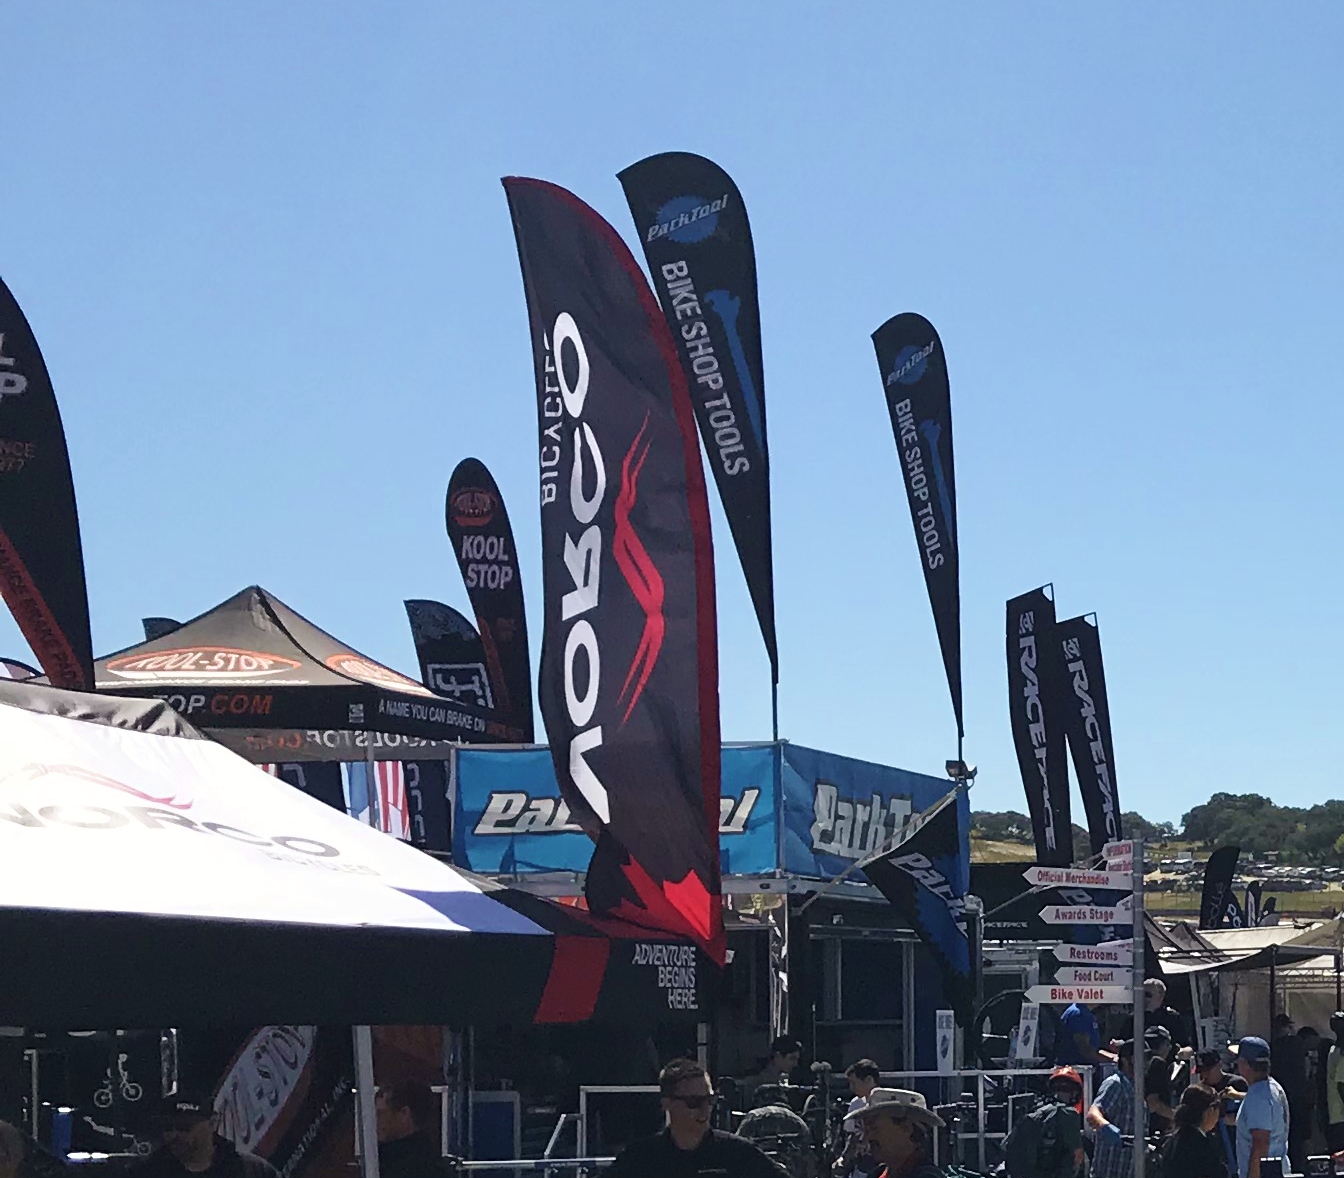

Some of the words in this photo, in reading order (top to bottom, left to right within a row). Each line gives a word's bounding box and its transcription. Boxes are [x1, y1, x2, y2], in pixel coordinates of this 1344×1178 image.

[661, 259, 702, 321] BIKE
[681, 320, 724, 391] SHOP
[705, 391, 750, 477] TOOLS
[895, 398, 918, 448] BIKE
[904, 446, 929, 501] SHOP
[461, 534, 509, 562] KOOL
[917, 502, 945, 570] TOOLS
[466, 563, 514, 590] STOP
[410, 704, 429, 721] YOU
[428, 706, 446, 723] CAN
[446, 709, 473, 730] BRAKE
[1067, 660, 1118, 842] RACEFAC
[1037, 869, 1064, 882] Official
[1065, 871, 1110, 885] Merchandise
[1054, 908, 1087, 920] Awards
[1089, 908, 1115, 922] Stage
[632, 943, 697, 966] ADVENTURE
[1069, 946, 1119, 961] Restrooms
[658, 966, 696, 988] BEGINS
[1073, 970, 1092, 982] Food
[1093, 971, 1114, 983] Court
[1050, 989, 1074, 1000] Bike
